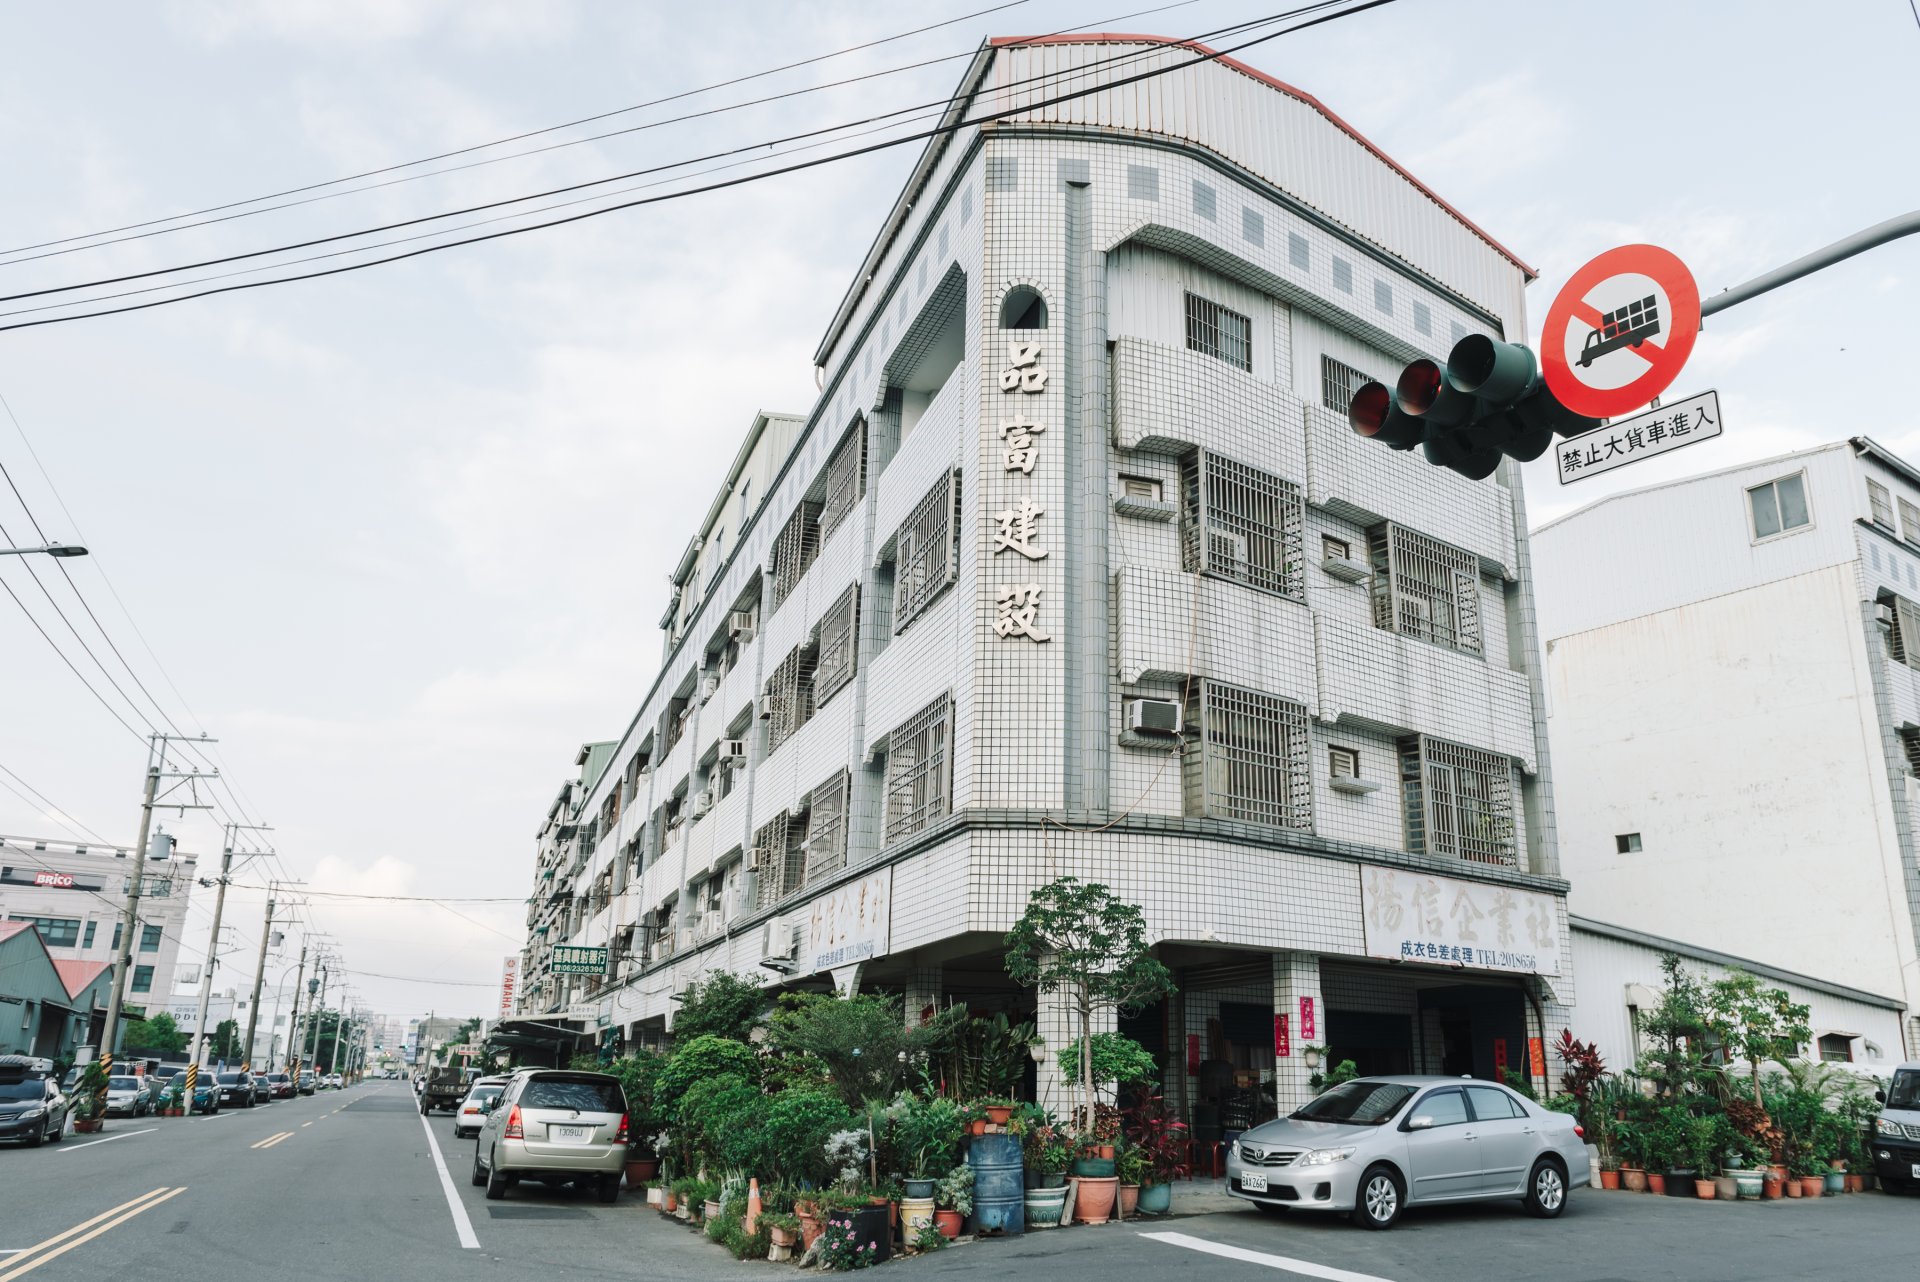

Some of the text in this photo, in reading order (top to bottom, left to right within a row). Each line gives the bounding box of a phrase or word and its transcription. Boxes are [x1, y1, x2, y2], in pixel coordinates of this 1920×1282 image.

[1563, 406, 1714, 472] 禁止大貨車進入
[992, 341, 1051, 642] 品富建設
[1401, 940, 1474, 963] 成衣色差處理
[502, 972, 515, 1008] YAMAHA
